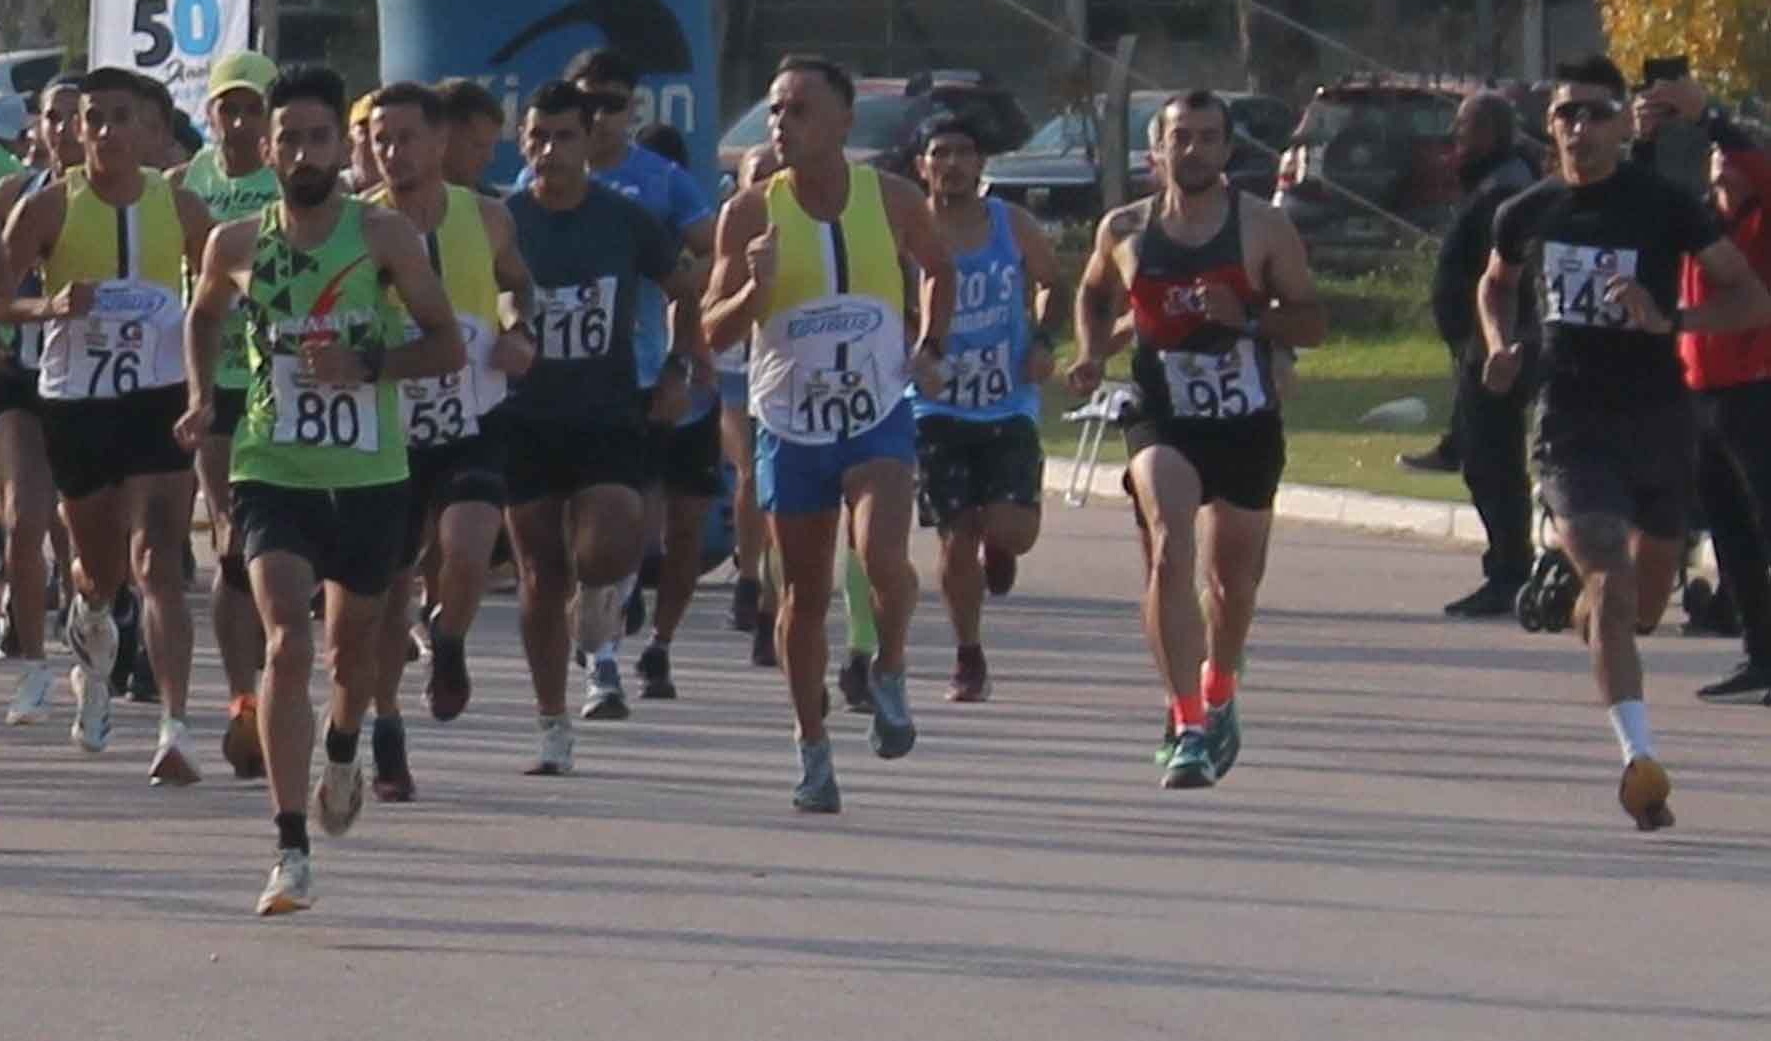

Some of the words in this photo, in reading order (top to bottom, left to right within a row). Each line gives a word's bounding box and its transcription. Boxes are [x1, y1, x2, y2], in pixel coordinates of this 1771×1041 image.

[532, 306, 607, 356] 116
[87, 350, 140, 397] 76
[942, 367, 1007, 406] 119
[1188, 370, 1248, 418] 95
[296, 391, 359, 447] 80
[410, 397, 464, 446] 53
[798, 387, 877, 437] 109
